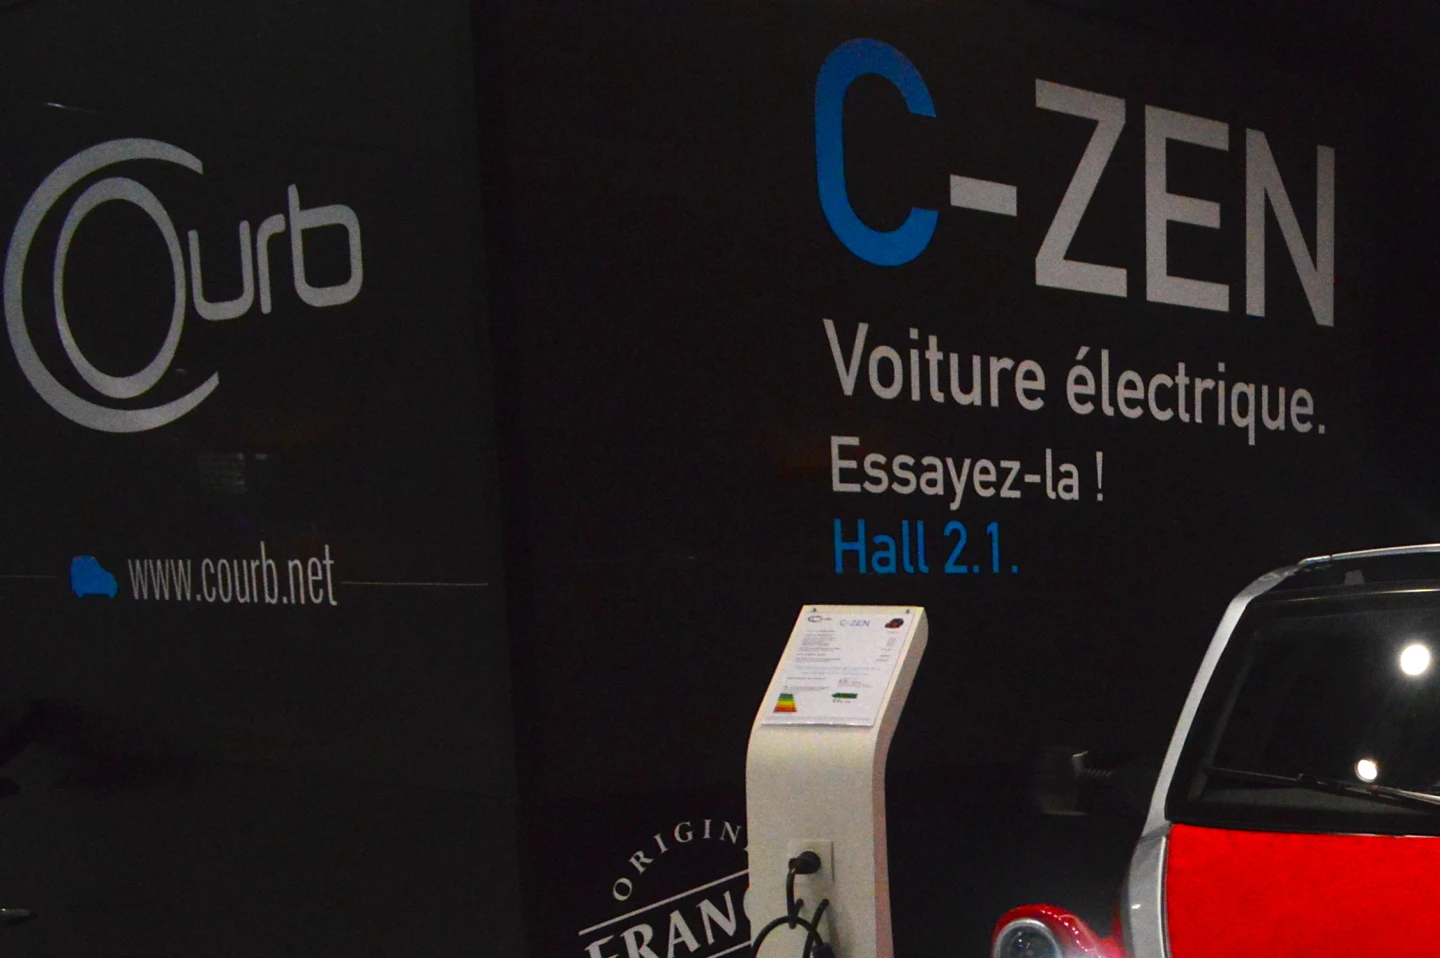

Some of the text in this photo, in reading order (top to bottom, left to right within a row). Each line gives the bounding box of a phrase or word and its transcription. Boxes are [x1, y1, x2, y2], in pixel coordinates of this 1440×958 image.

[815, 37, 1335, 328] C-ZEN
[822, 318, 1326, 446] Voiture électrique.
[829, 435, 1080, 511] Essayez-la
[127, 540, 338, 607] www.courb.net
[834, 519, 1019, 574] Hall 2.1.
[612, 818, 748, 901] ORIGIN
